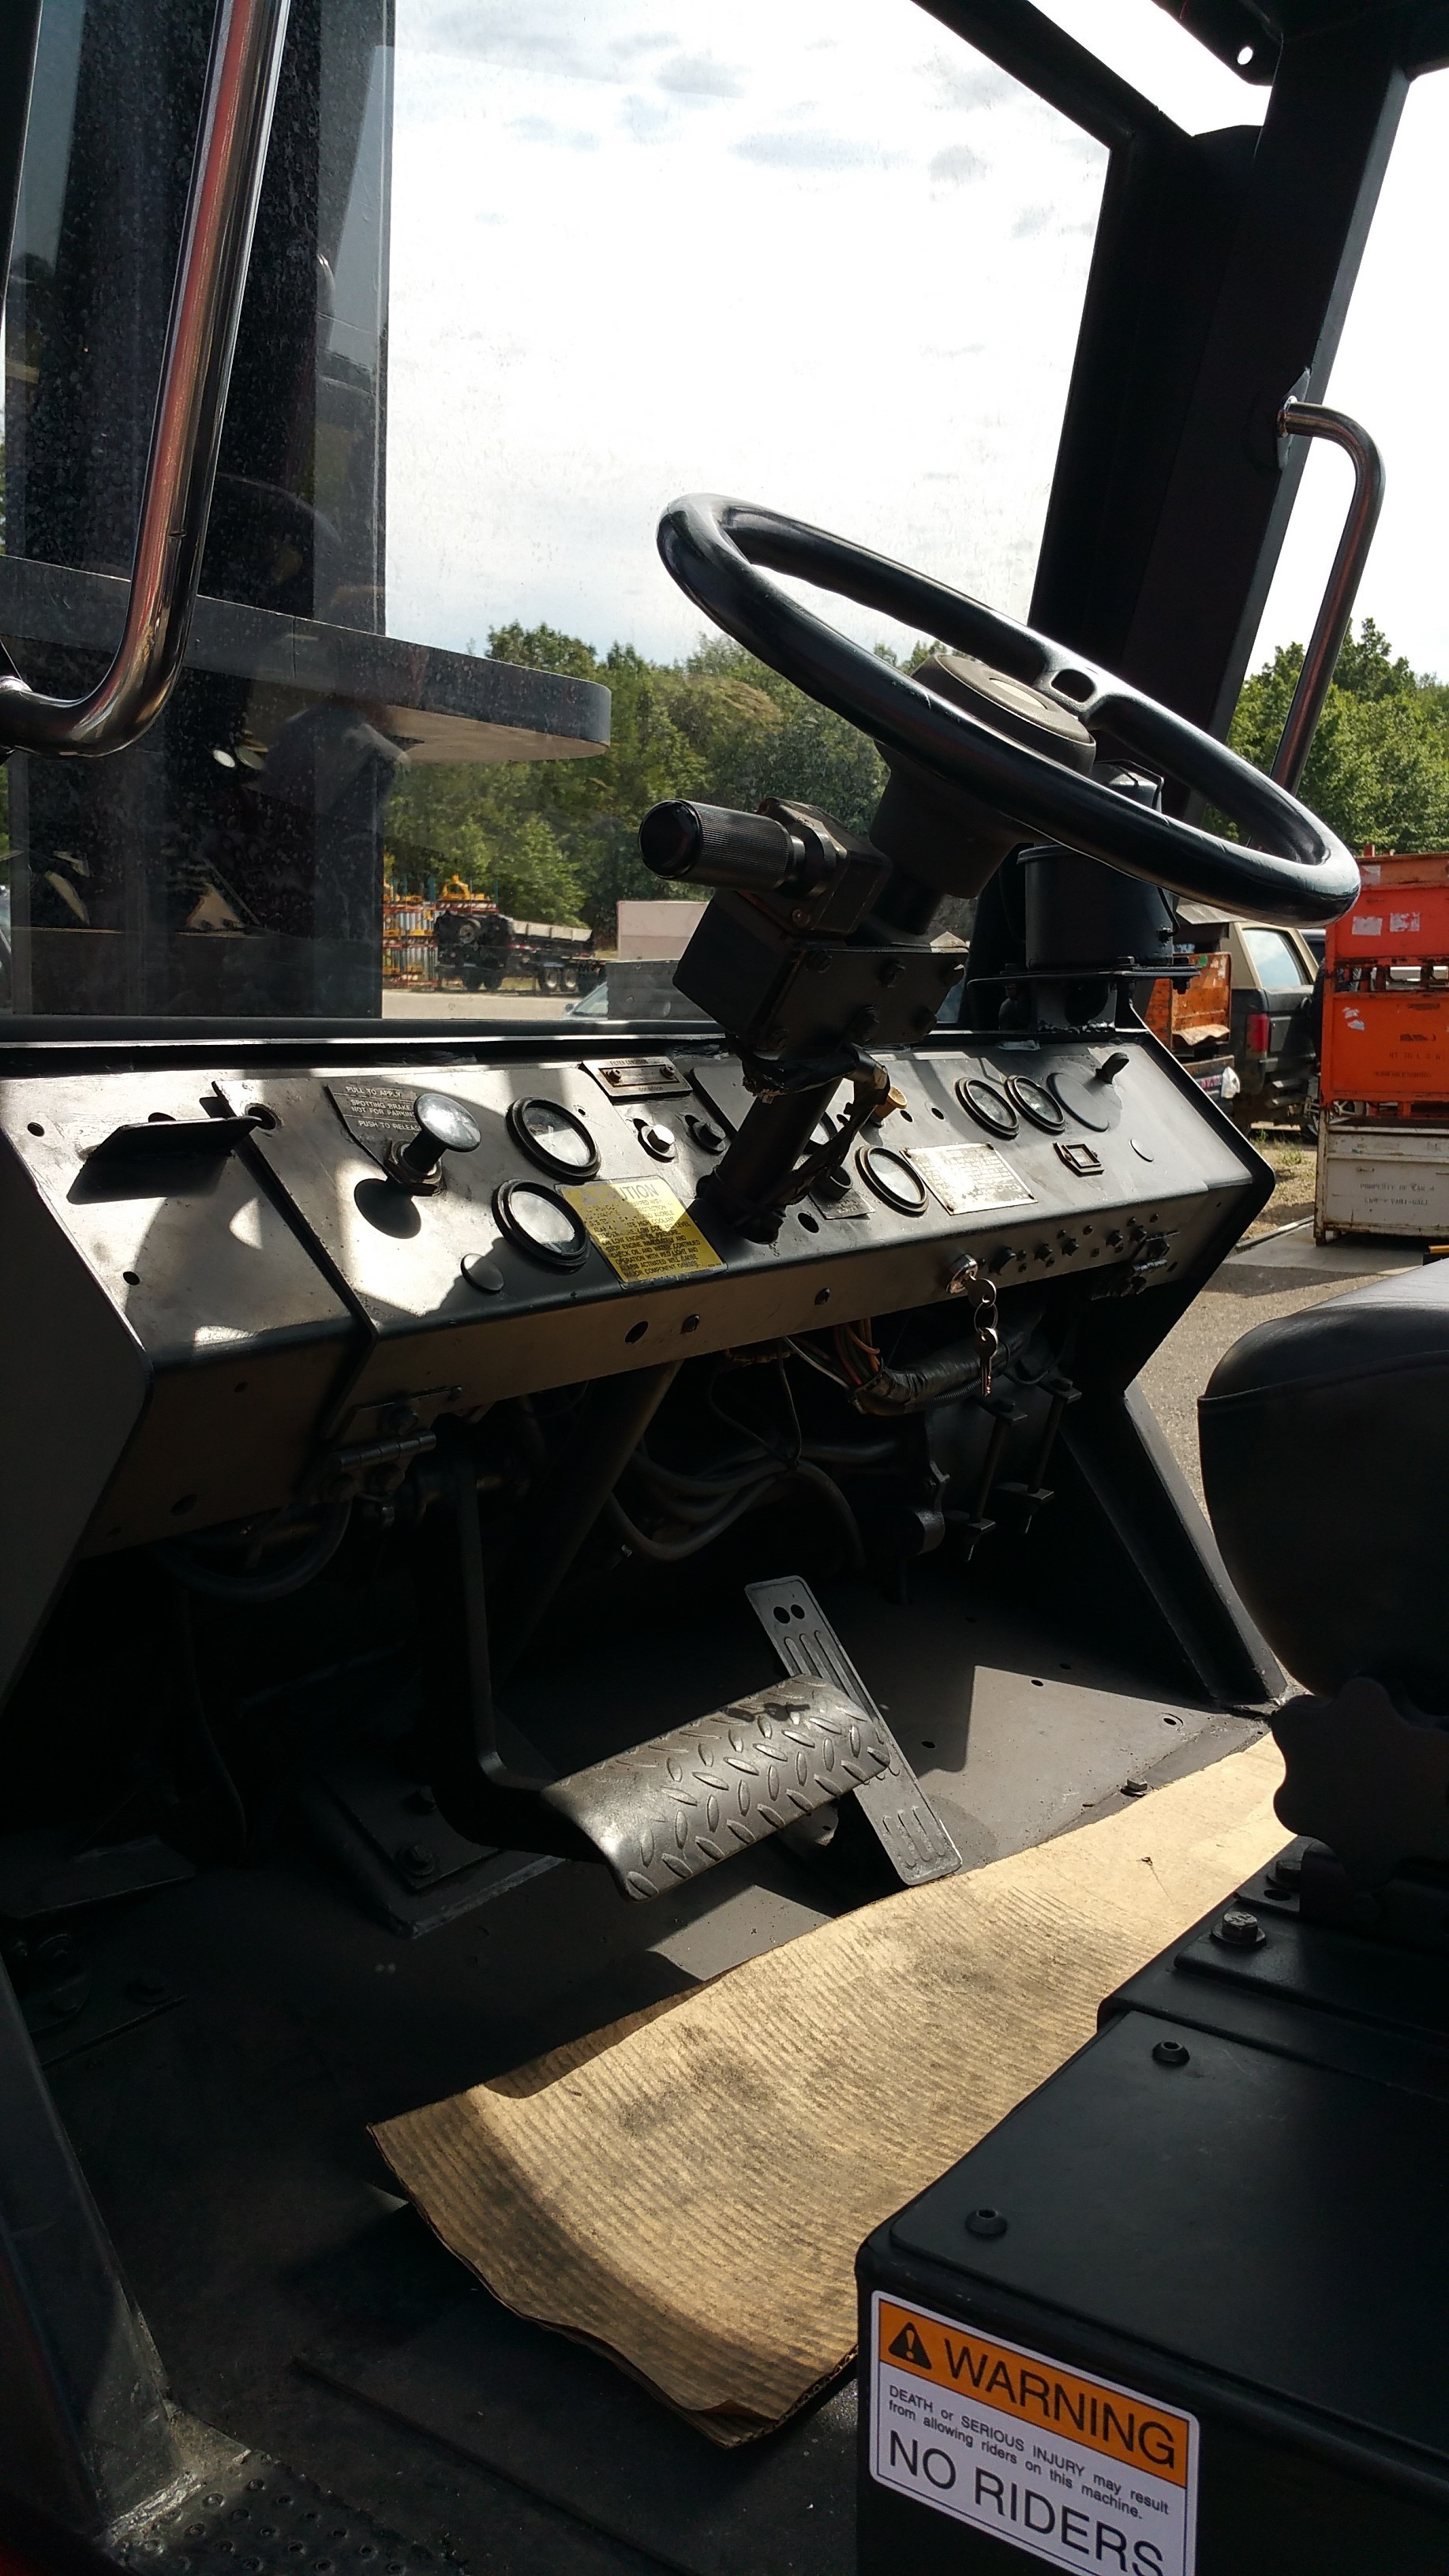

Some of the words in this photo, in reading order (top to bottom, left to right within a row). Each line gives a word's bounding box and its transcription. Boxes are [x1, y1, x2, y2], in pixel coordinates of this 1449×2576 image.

[350, 1099, 386, 1109] SPOTTING
[610, 1250, 630, 1259] CHECK
[673, 1240, 701, 1249] CONTINUED
[616, 1255, 646, 1265] OPERATION
[641, 1259, 667, 1268] ACTIVATED
[646, 1264, 676, 1275] COMPONENT
[943, 2338, 1175, 2469] WARNING
[889, 2385, 934, 2413] DEATH
[941, 2408, 954, 2422] or
[960, 2415, 1024, 2451] SERIOUS
[1032, 2446, 1086, 2477] INJURY
[1094, 2472, 1122, 2496] may
[1130, 2489, 1170, 2515] result
[889, 2399, 916, 2421] from
[923, 2416, 974, 2448] allowing
[981, 2439, 1017, 2465] riders
[1025, 2461, 1042, 2477] on
[1050, 2469, 1073, 2489] this
[1081, 2485, 1143, 2520] machine.
[889, 2430, 957, 2490] NO
[974, 2466, 1165, 2576] RIDERS
